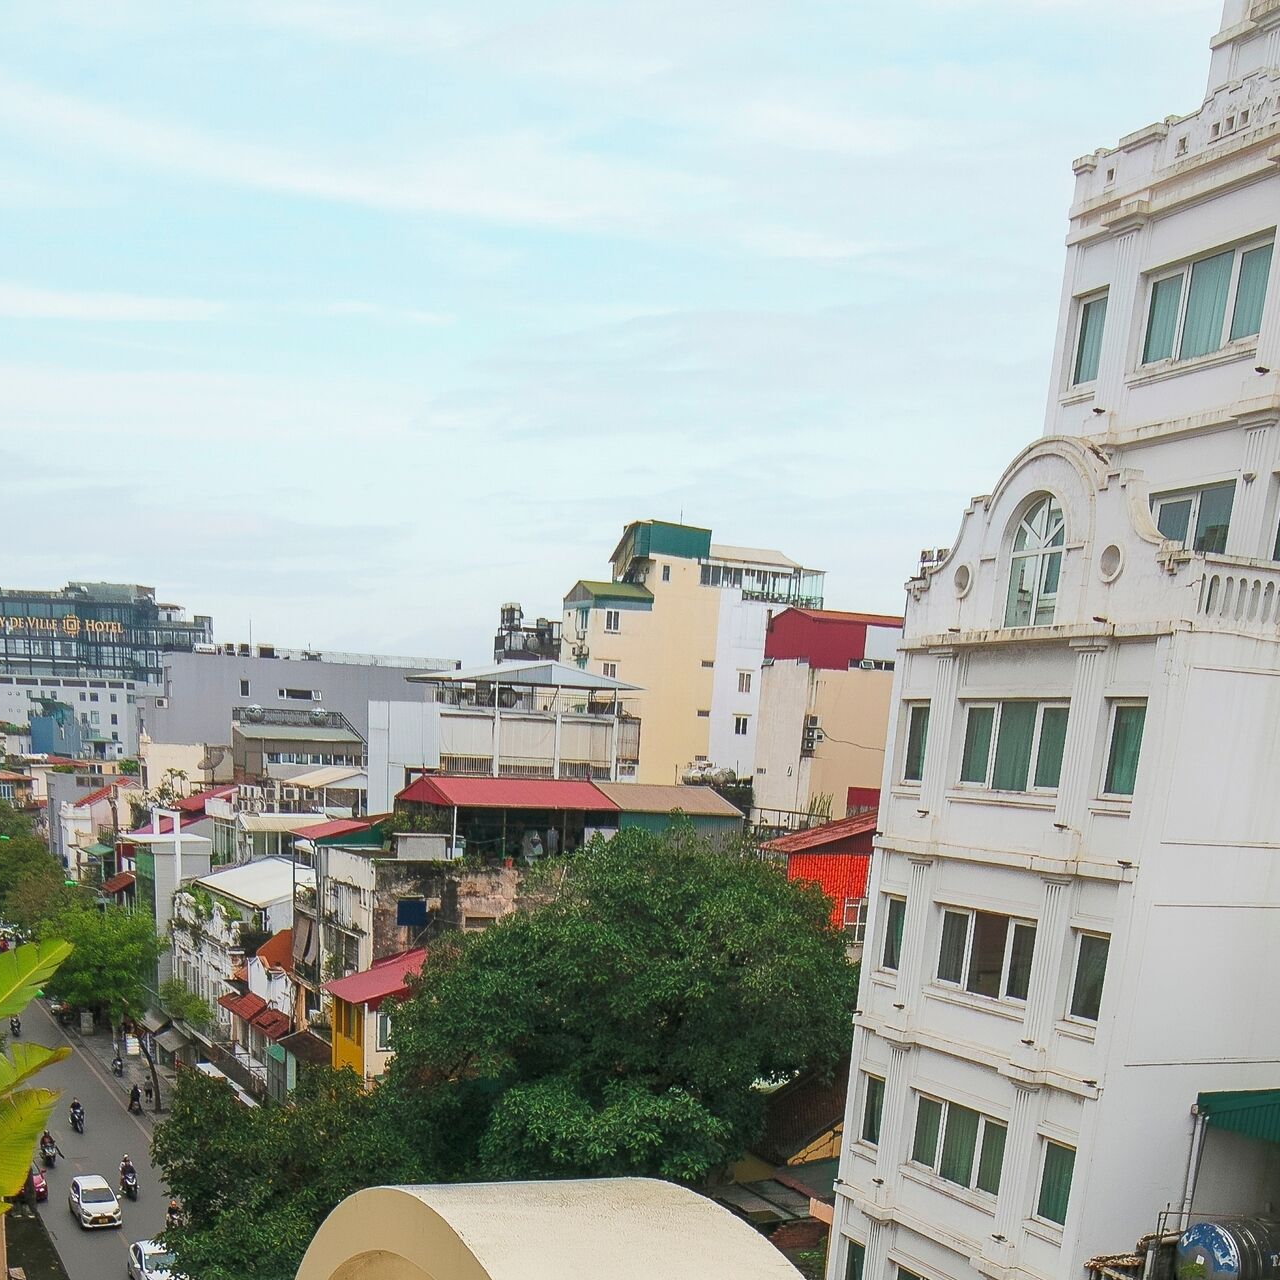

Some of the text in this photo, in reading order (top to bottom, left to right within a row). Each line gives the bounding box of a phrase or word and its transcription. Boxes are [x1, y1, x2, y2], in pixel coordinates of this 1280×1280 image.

[10, 617, 24, 629] DE
[26, 617, 57, 630] VILLE
[85, 620, 123, 634] HOTEL
